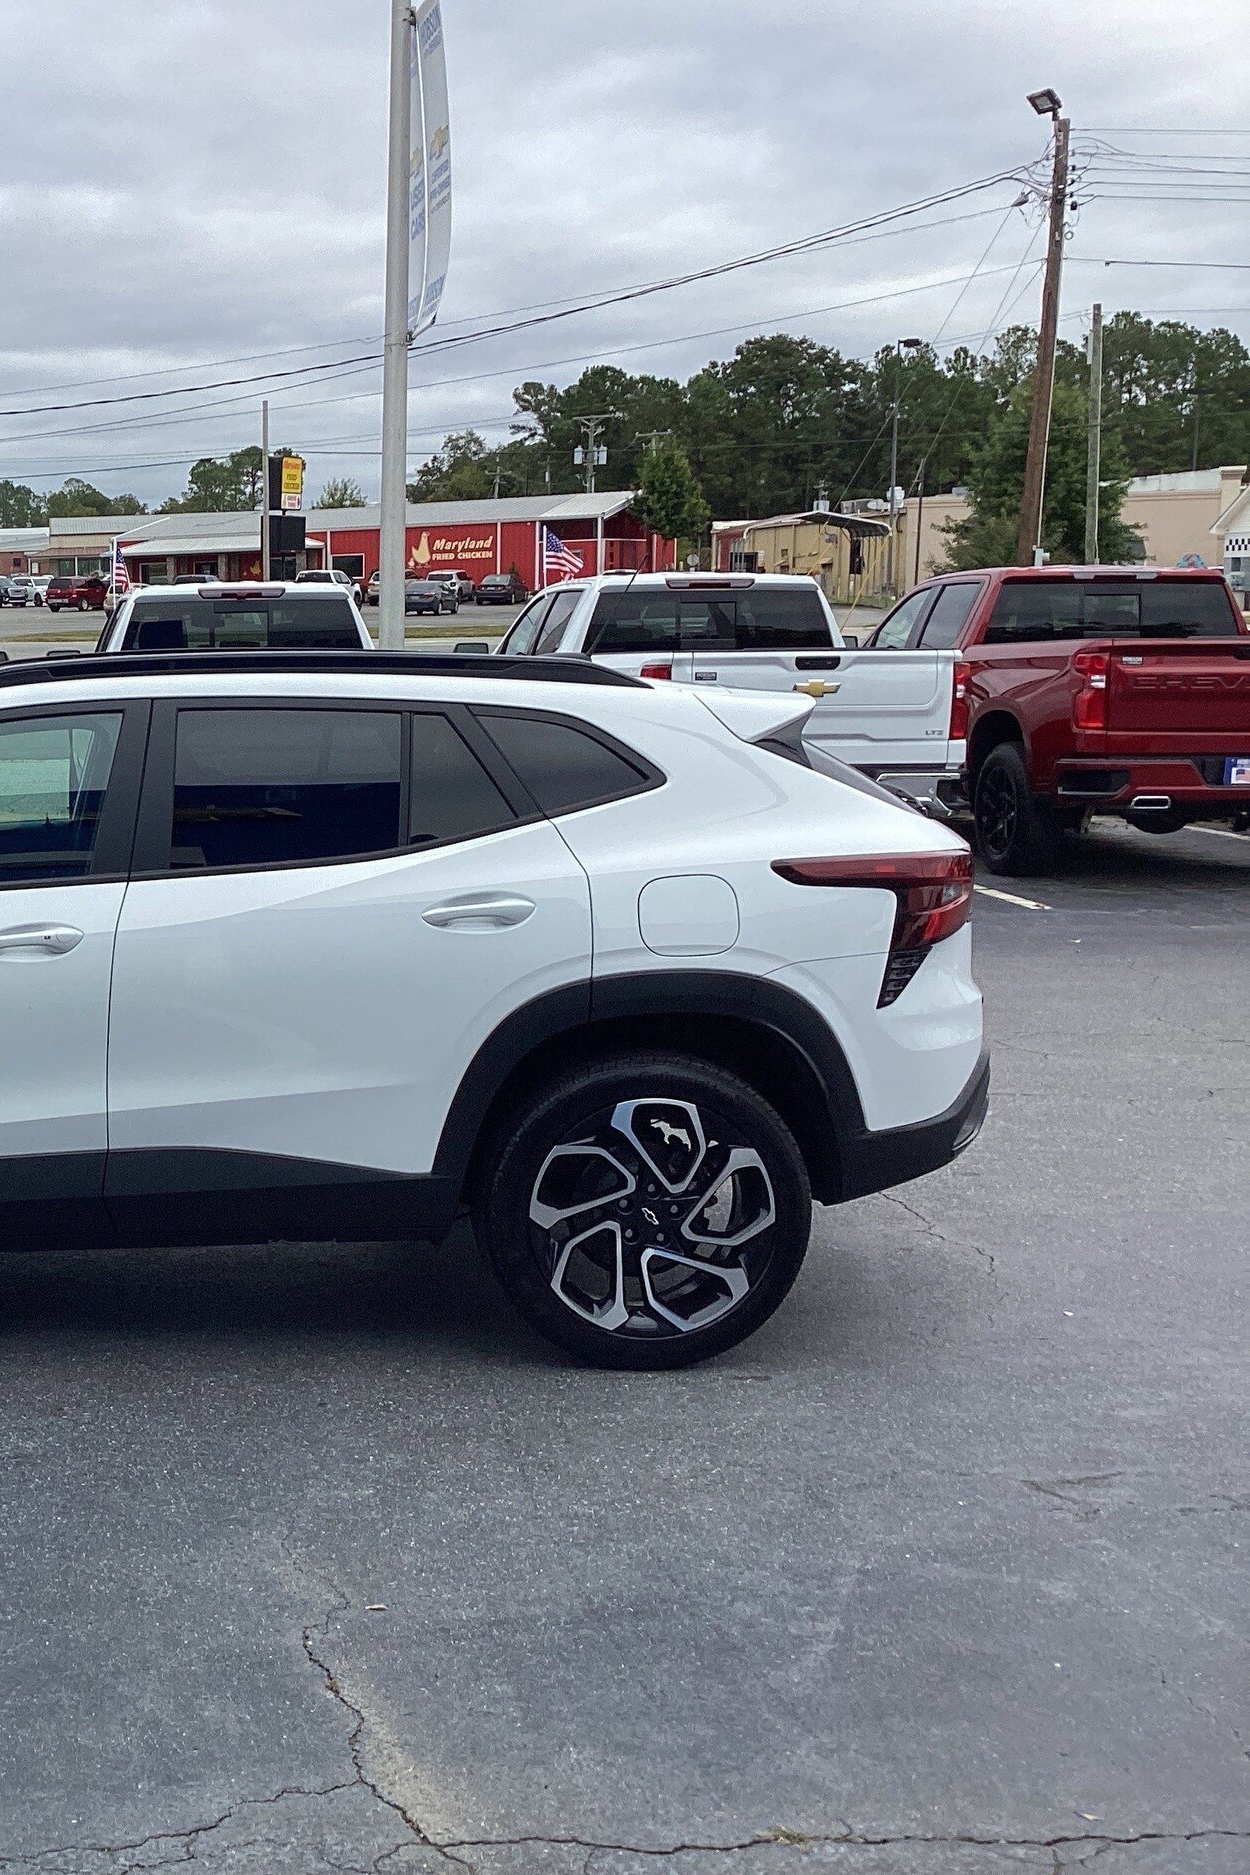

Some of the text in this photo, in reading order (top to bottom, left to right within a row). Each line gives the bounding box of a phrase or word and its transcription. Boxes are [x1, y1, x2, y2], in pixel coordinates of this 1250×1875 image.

[433, 535, 494, 553] Maryland
[432, 552, 455, 561] FRIED
[457, 550, 493, 560] CHICKEN
[1132, 676, 1250, 690] CHEV
